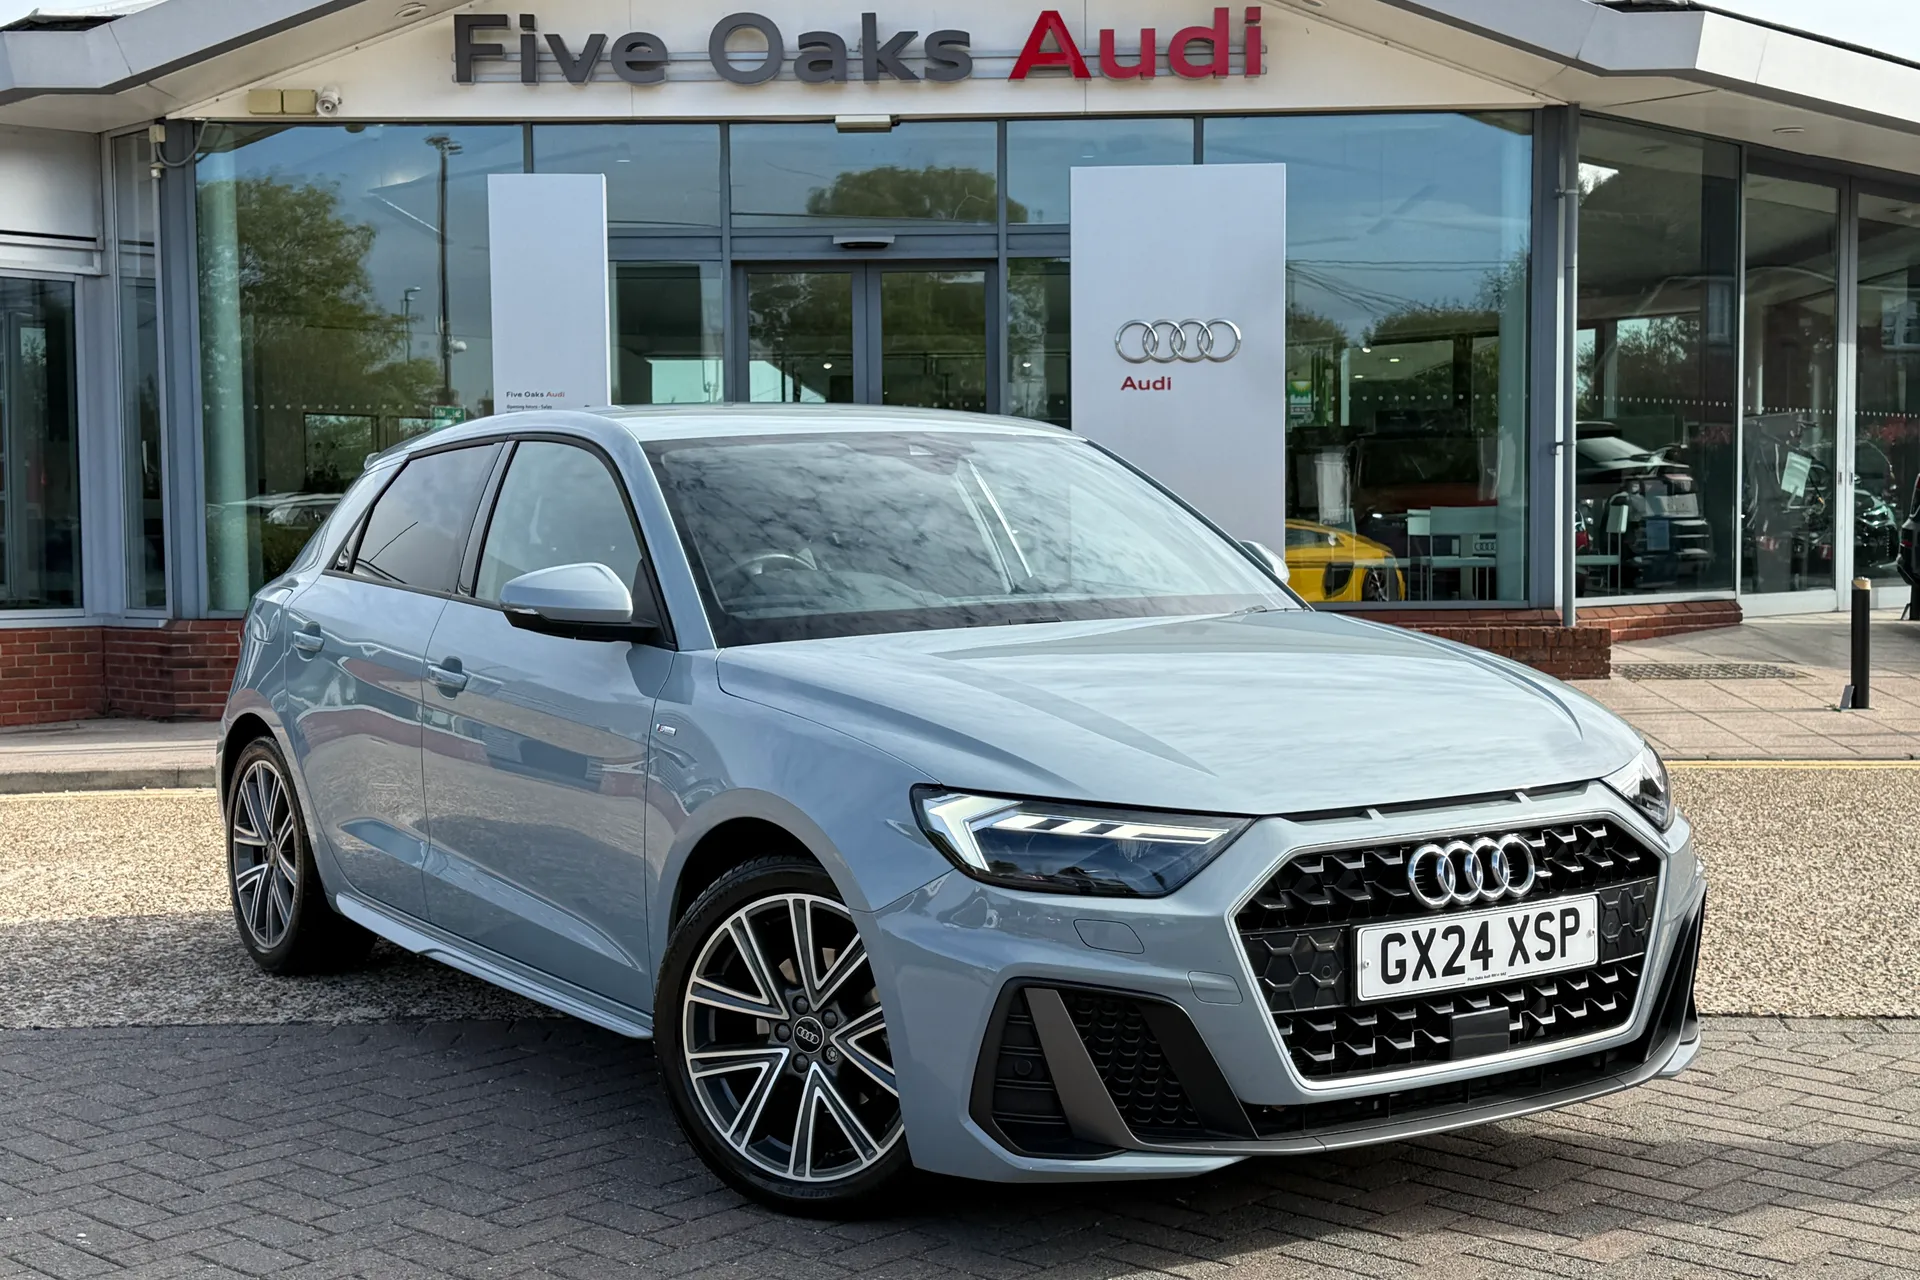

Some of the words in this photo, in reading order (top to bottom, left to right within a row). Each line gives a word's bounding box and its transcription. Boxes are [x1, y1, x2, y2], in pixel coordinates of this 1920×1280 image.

[454, 14, 669, 85] Five
[709, 12, 973, 84] Oaks
[1008, 6, 1262, 81] Audi
[1120, 376, 1172, 391] Audi
[1380, 920, 1494, 985] GX24
[1507, 907, 1580, 967] XSP
